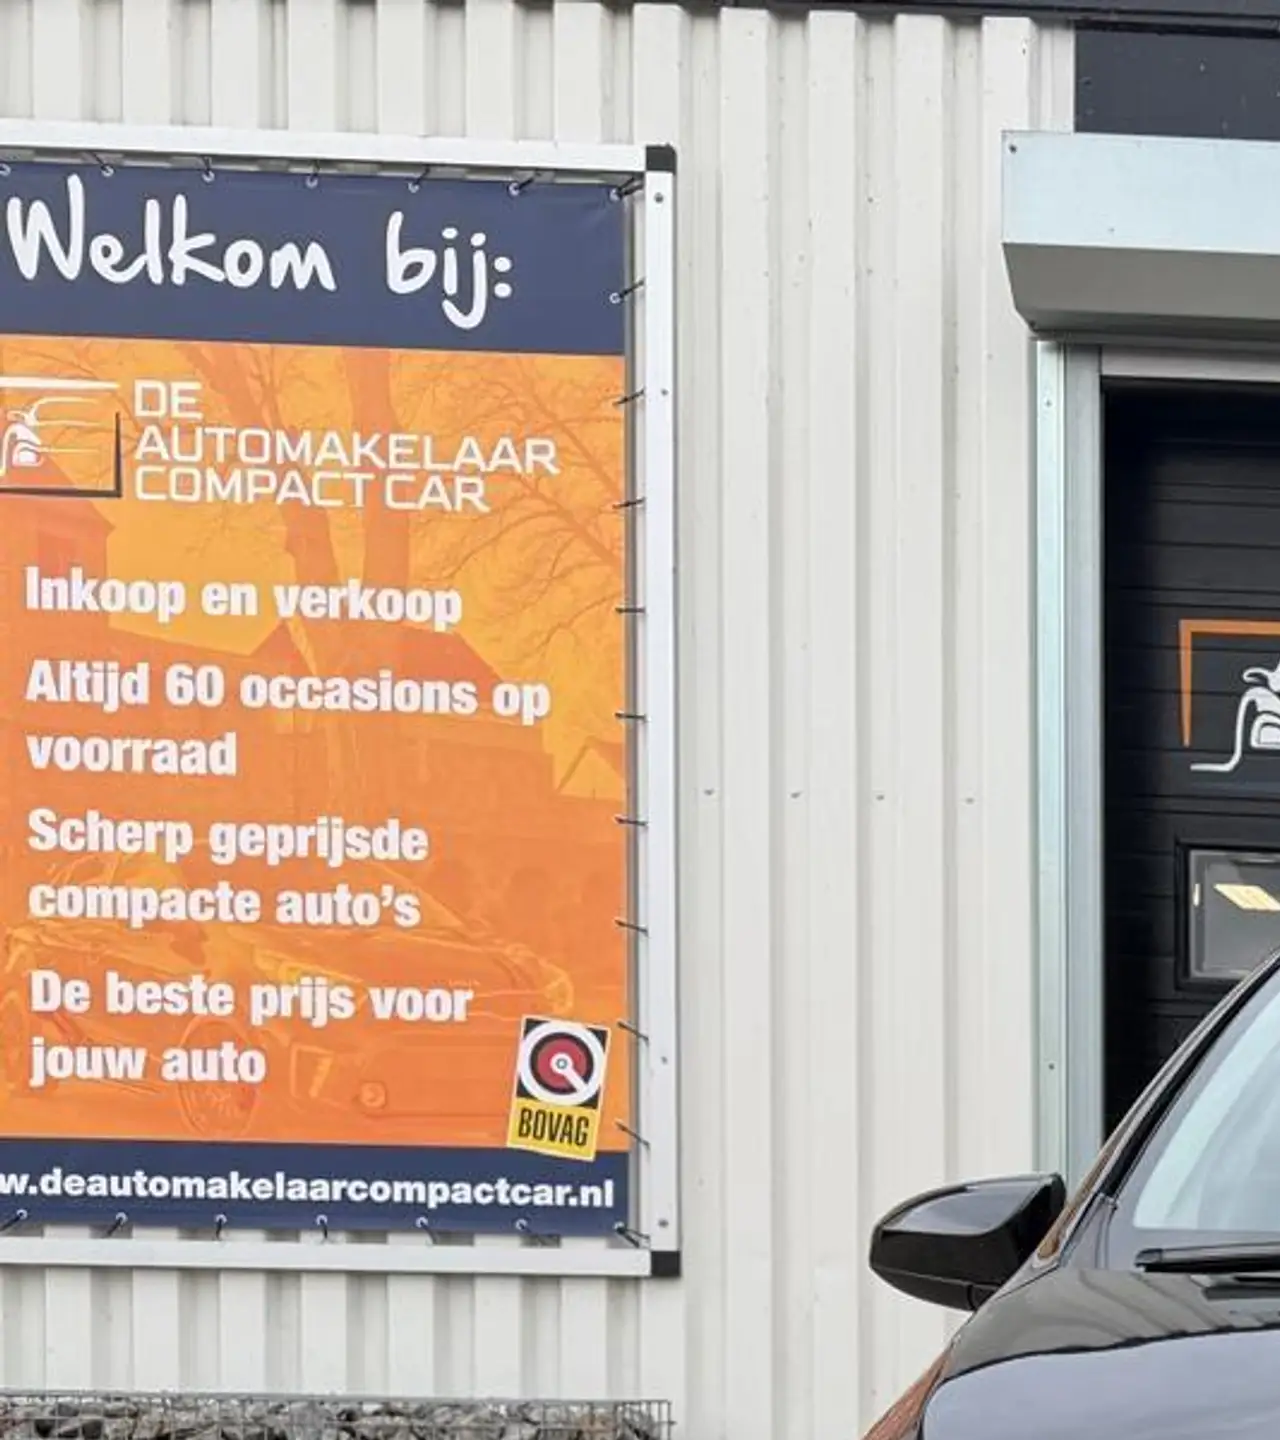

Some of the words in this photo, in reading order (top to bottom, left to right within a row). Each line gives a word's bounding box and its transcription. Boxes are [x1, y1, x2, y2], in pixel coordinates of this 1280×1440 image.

[5, 173, 337, 292] Welkom
[386, 211, 513, 329] bij:
[134, 380, 203, 421] DE
[135, 425, 559, 476] AUTOMAKELAAR
[135, 466, 365, 508] COMPACT
[384, 474, 491, 513] CAR
[26, 566, 186, 622] Inkoop
[202, 580, 258, 616] en
[274, 577, 463, 632] verkoop
[26, 658, 150, 714] Altijd
[164, 663, 224, 707] 60
[240, 669, 478, 716] occasions
[492, 680, 551, 726] op
[27, 731, 237, 777] voorraad
[28, 807, 194, 862] Scherp
[209, 815, 429, 868] geprijsde
[28, 880, 261, 929] compacte
[275, 884, 421, 928] auto's
[30, 970, 91, 1015] De
[106, 971, 235, 1018] beste
[250, 977, 355, 1028] prijs
[369, 985, 474, 1022] voor
[29, 1037, 145, 1088] jouw
[162, 1041, 266, 1085] auto
[518, 1107, 590, 1147] BOVAG
